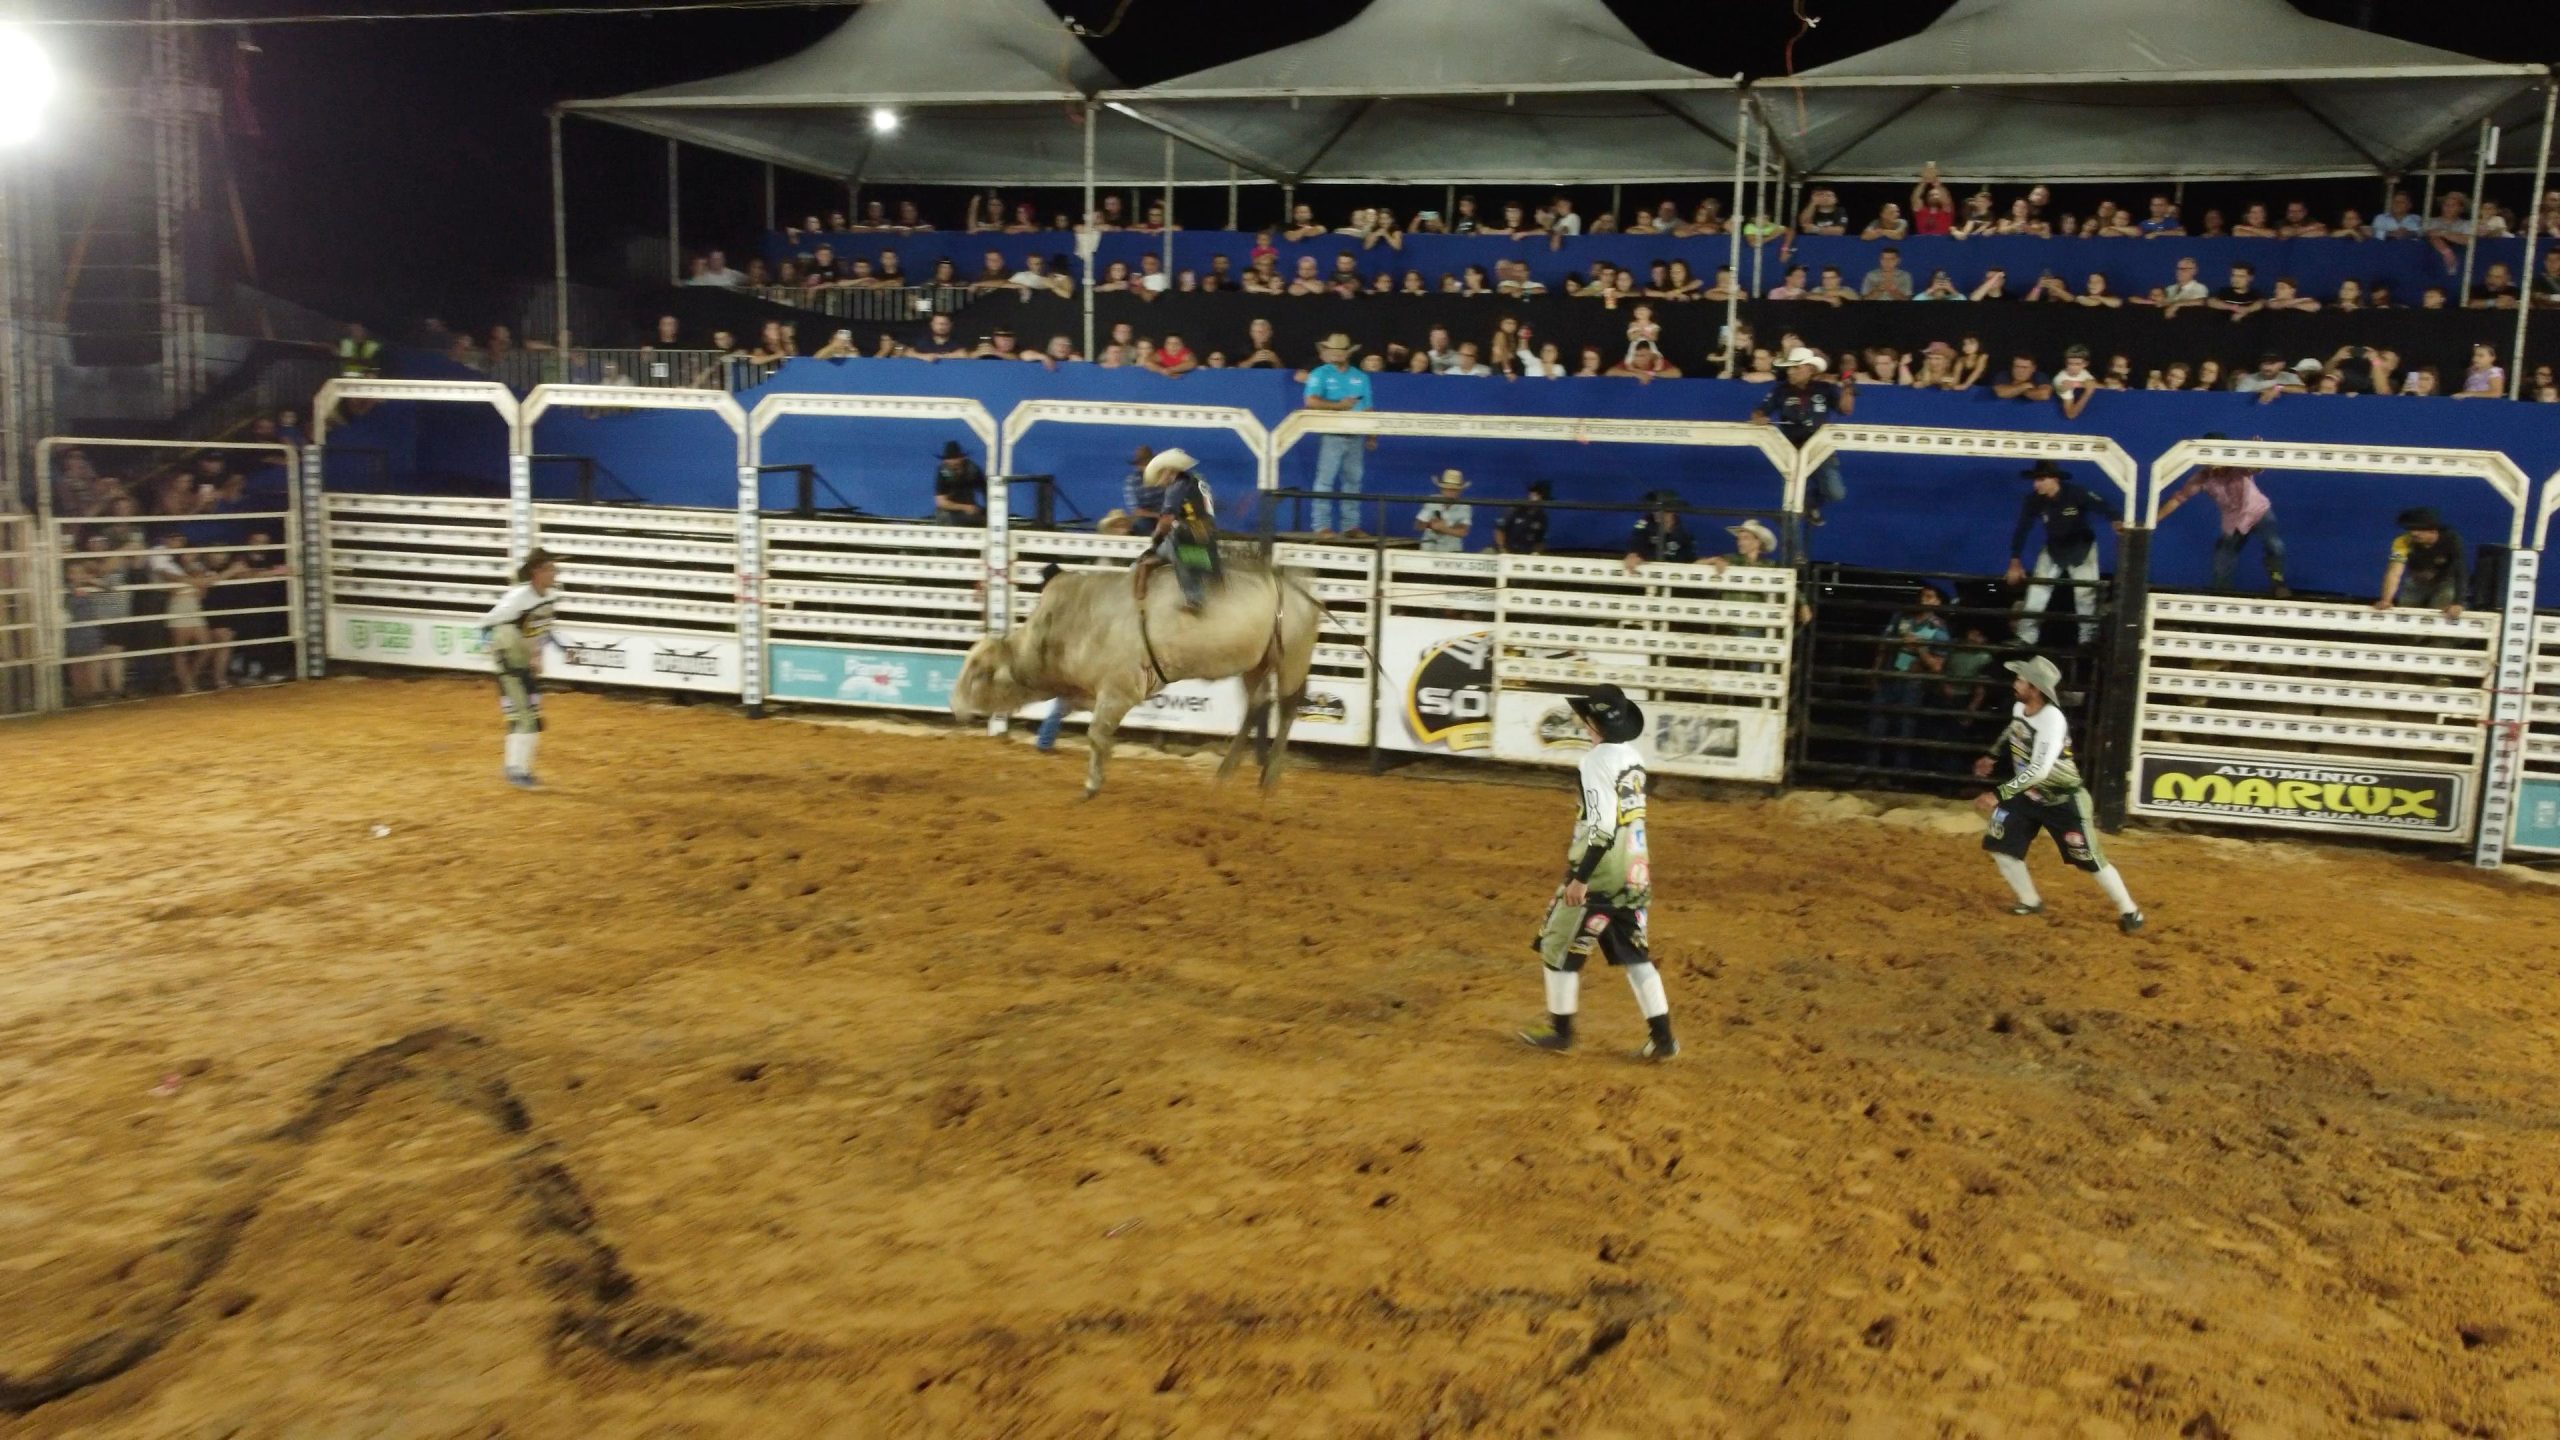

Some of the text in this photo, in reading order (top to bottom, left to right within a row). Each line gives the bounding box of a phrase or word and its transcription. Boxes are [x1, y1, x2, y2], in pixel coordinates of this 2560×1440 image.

[1418, 684, 1489, 718] SÓ
[2215, 765, 2381, 785] ALUMÍNIO
[2152, 772, 2438, 818] MARLUX
[2151, 799, 2436, 827] GARANTIA DE QUALIDADE
